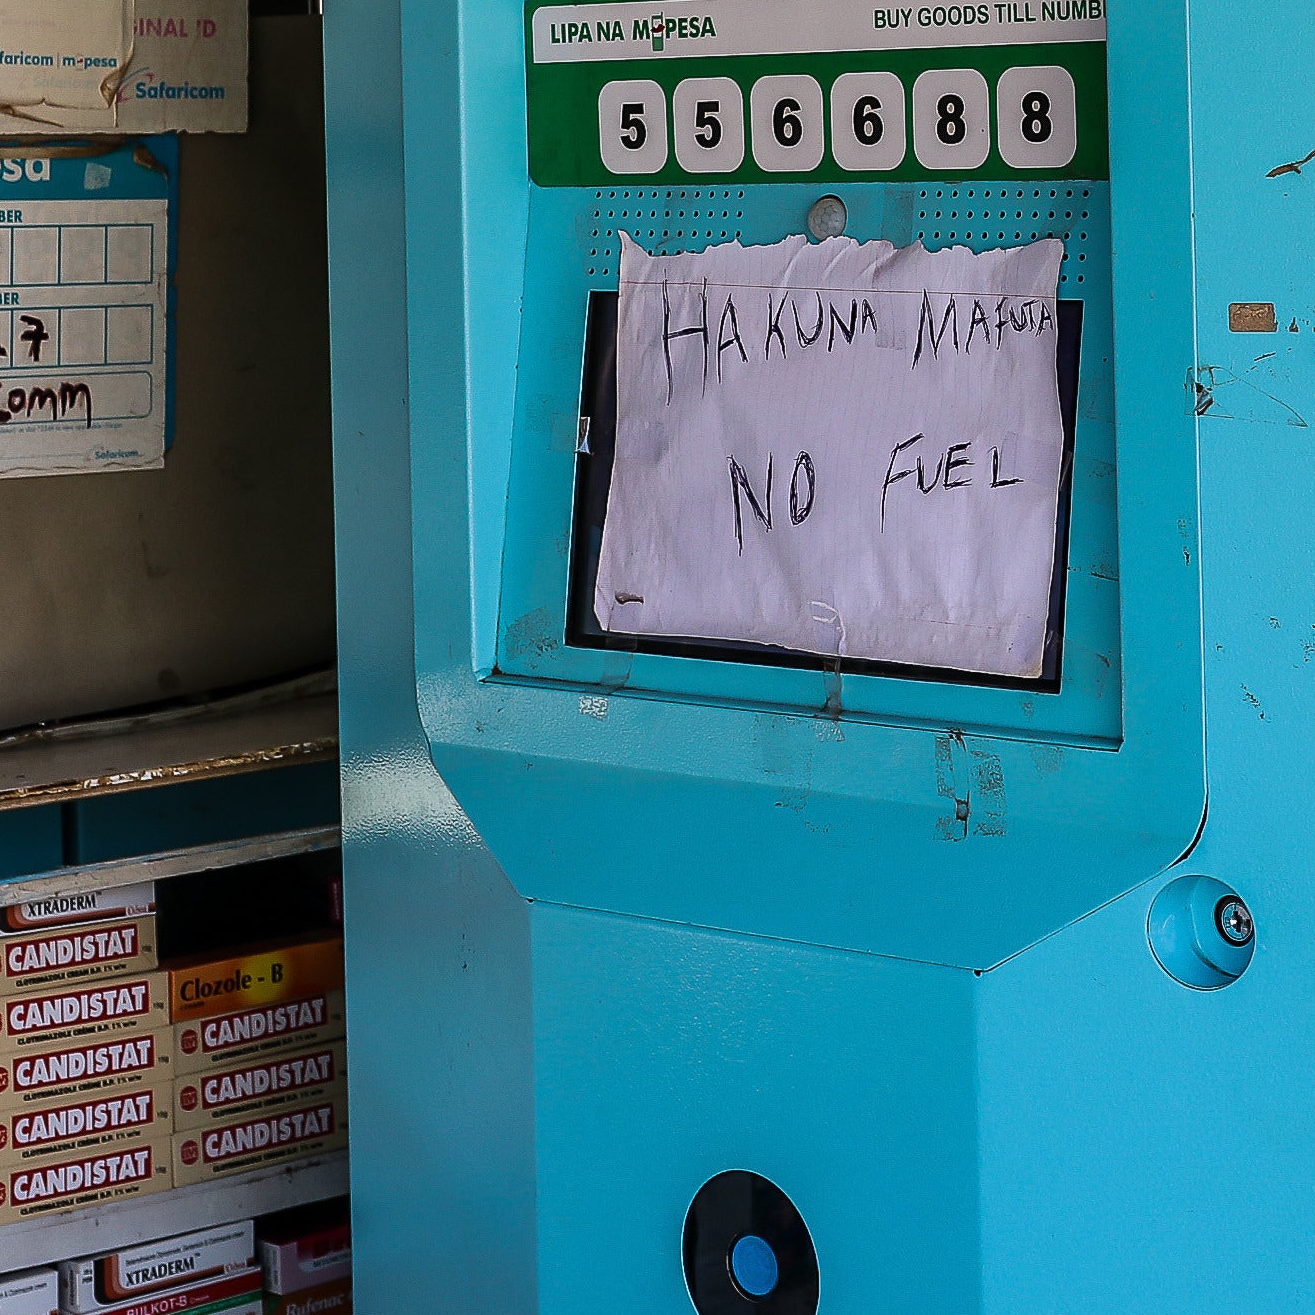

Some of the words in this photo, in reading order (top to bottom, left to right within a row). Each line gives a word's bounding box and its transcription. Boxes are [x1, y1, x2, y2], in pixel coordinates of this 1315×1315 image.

[596, 19, 624, 42] NA
[874, 6, 913, 29] BUY
[917, 3, 990, 28] GOODS
[993, 1, 1037, 24] TILL
[135, 81, 225, 101] Safaricom
[662, 268, 878, 406] HAKUNA
[911, 289, 1057, 370] MAFUTA
[727, 451, 816, 557] NO
[880, 433, 1024, 534] FUEL
[9, 928, 135, 971] CANDISTAT
[206, 1110, 331, 1158] CANDISTAT
[126, 1258, 194, 1287] XTRADERM
